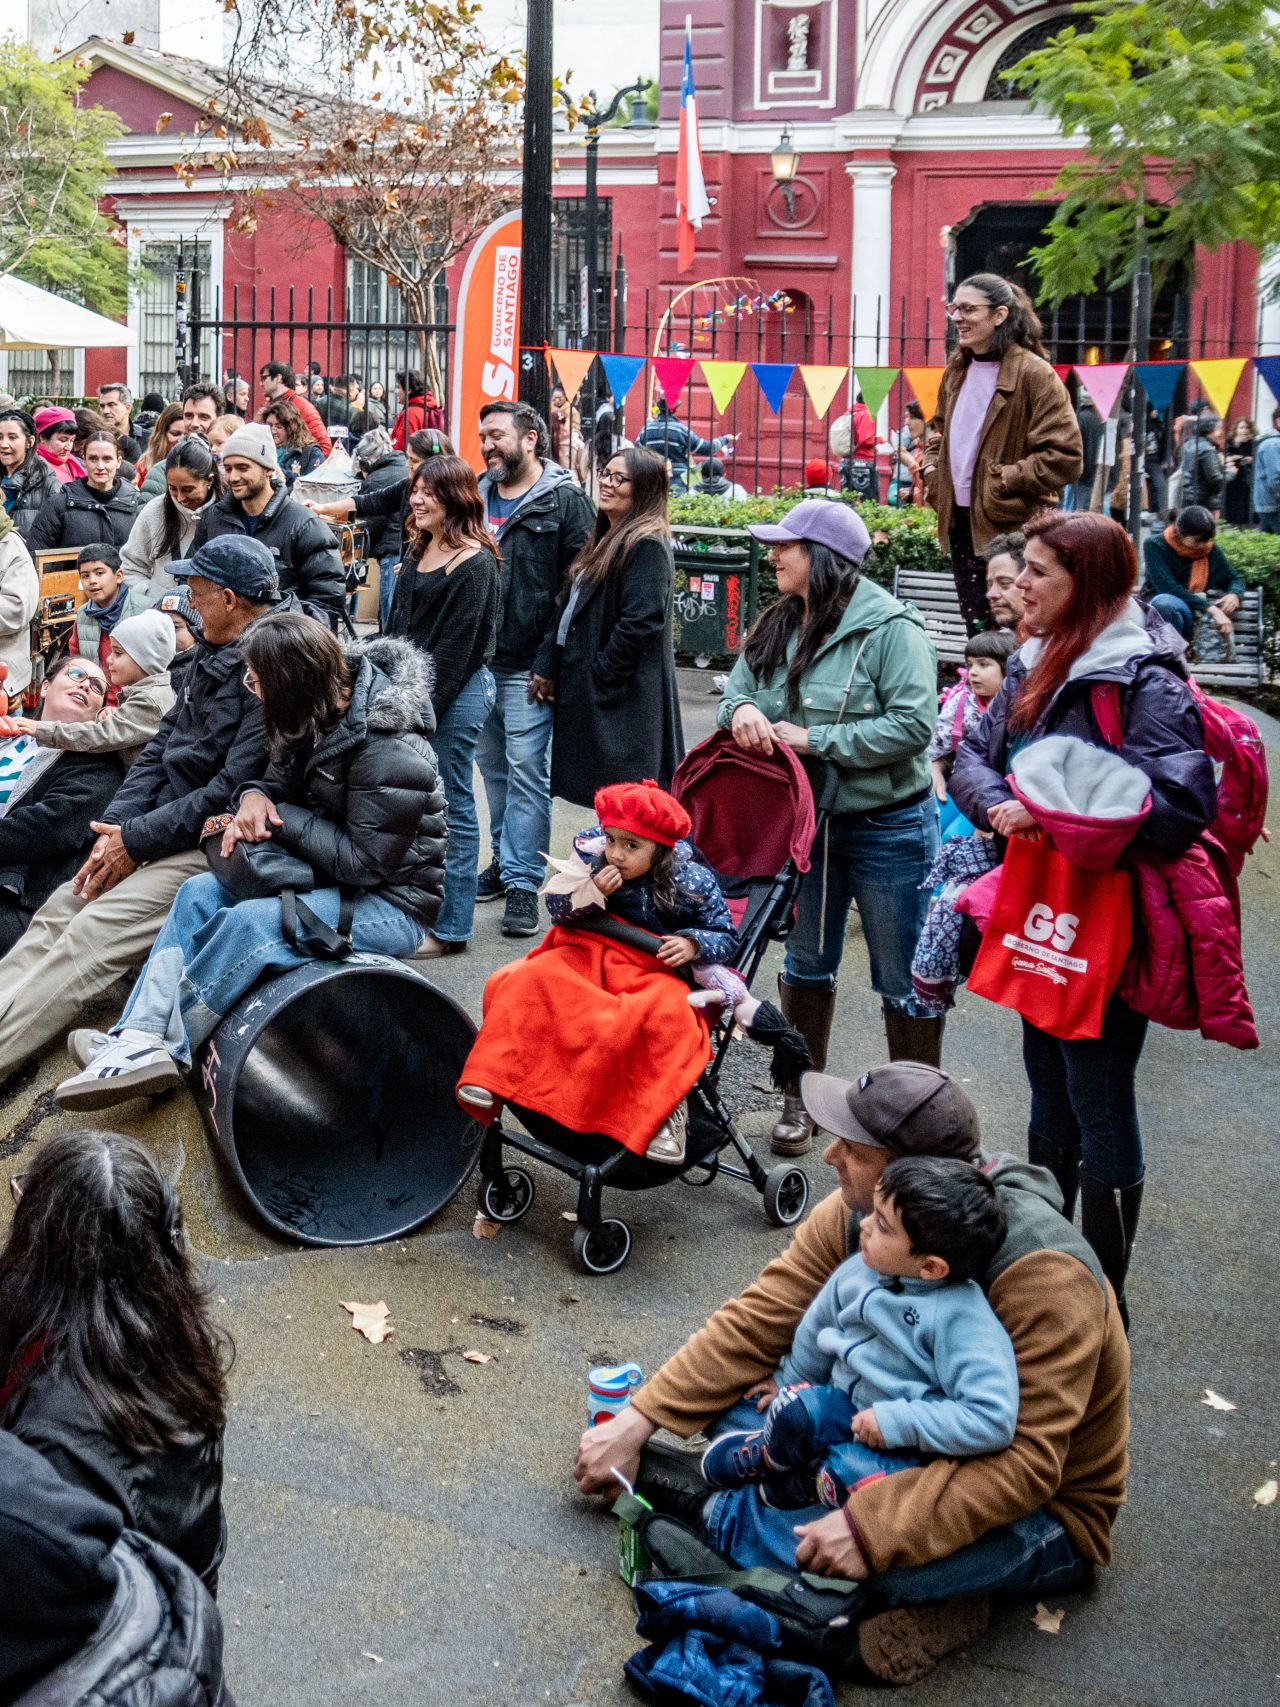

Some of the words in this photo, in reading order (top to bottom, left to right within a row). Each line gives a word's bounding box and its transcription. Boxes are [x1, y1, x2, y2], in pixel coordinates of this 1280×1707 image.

[498, 254, 507, 272] DE
[493, 276, 505, 347] GOBIERNO
[503, 255, 518, 347] SANTIAGO
[522, 353, 534, 370] 3
[1023, 902, 1080, 952] GS
